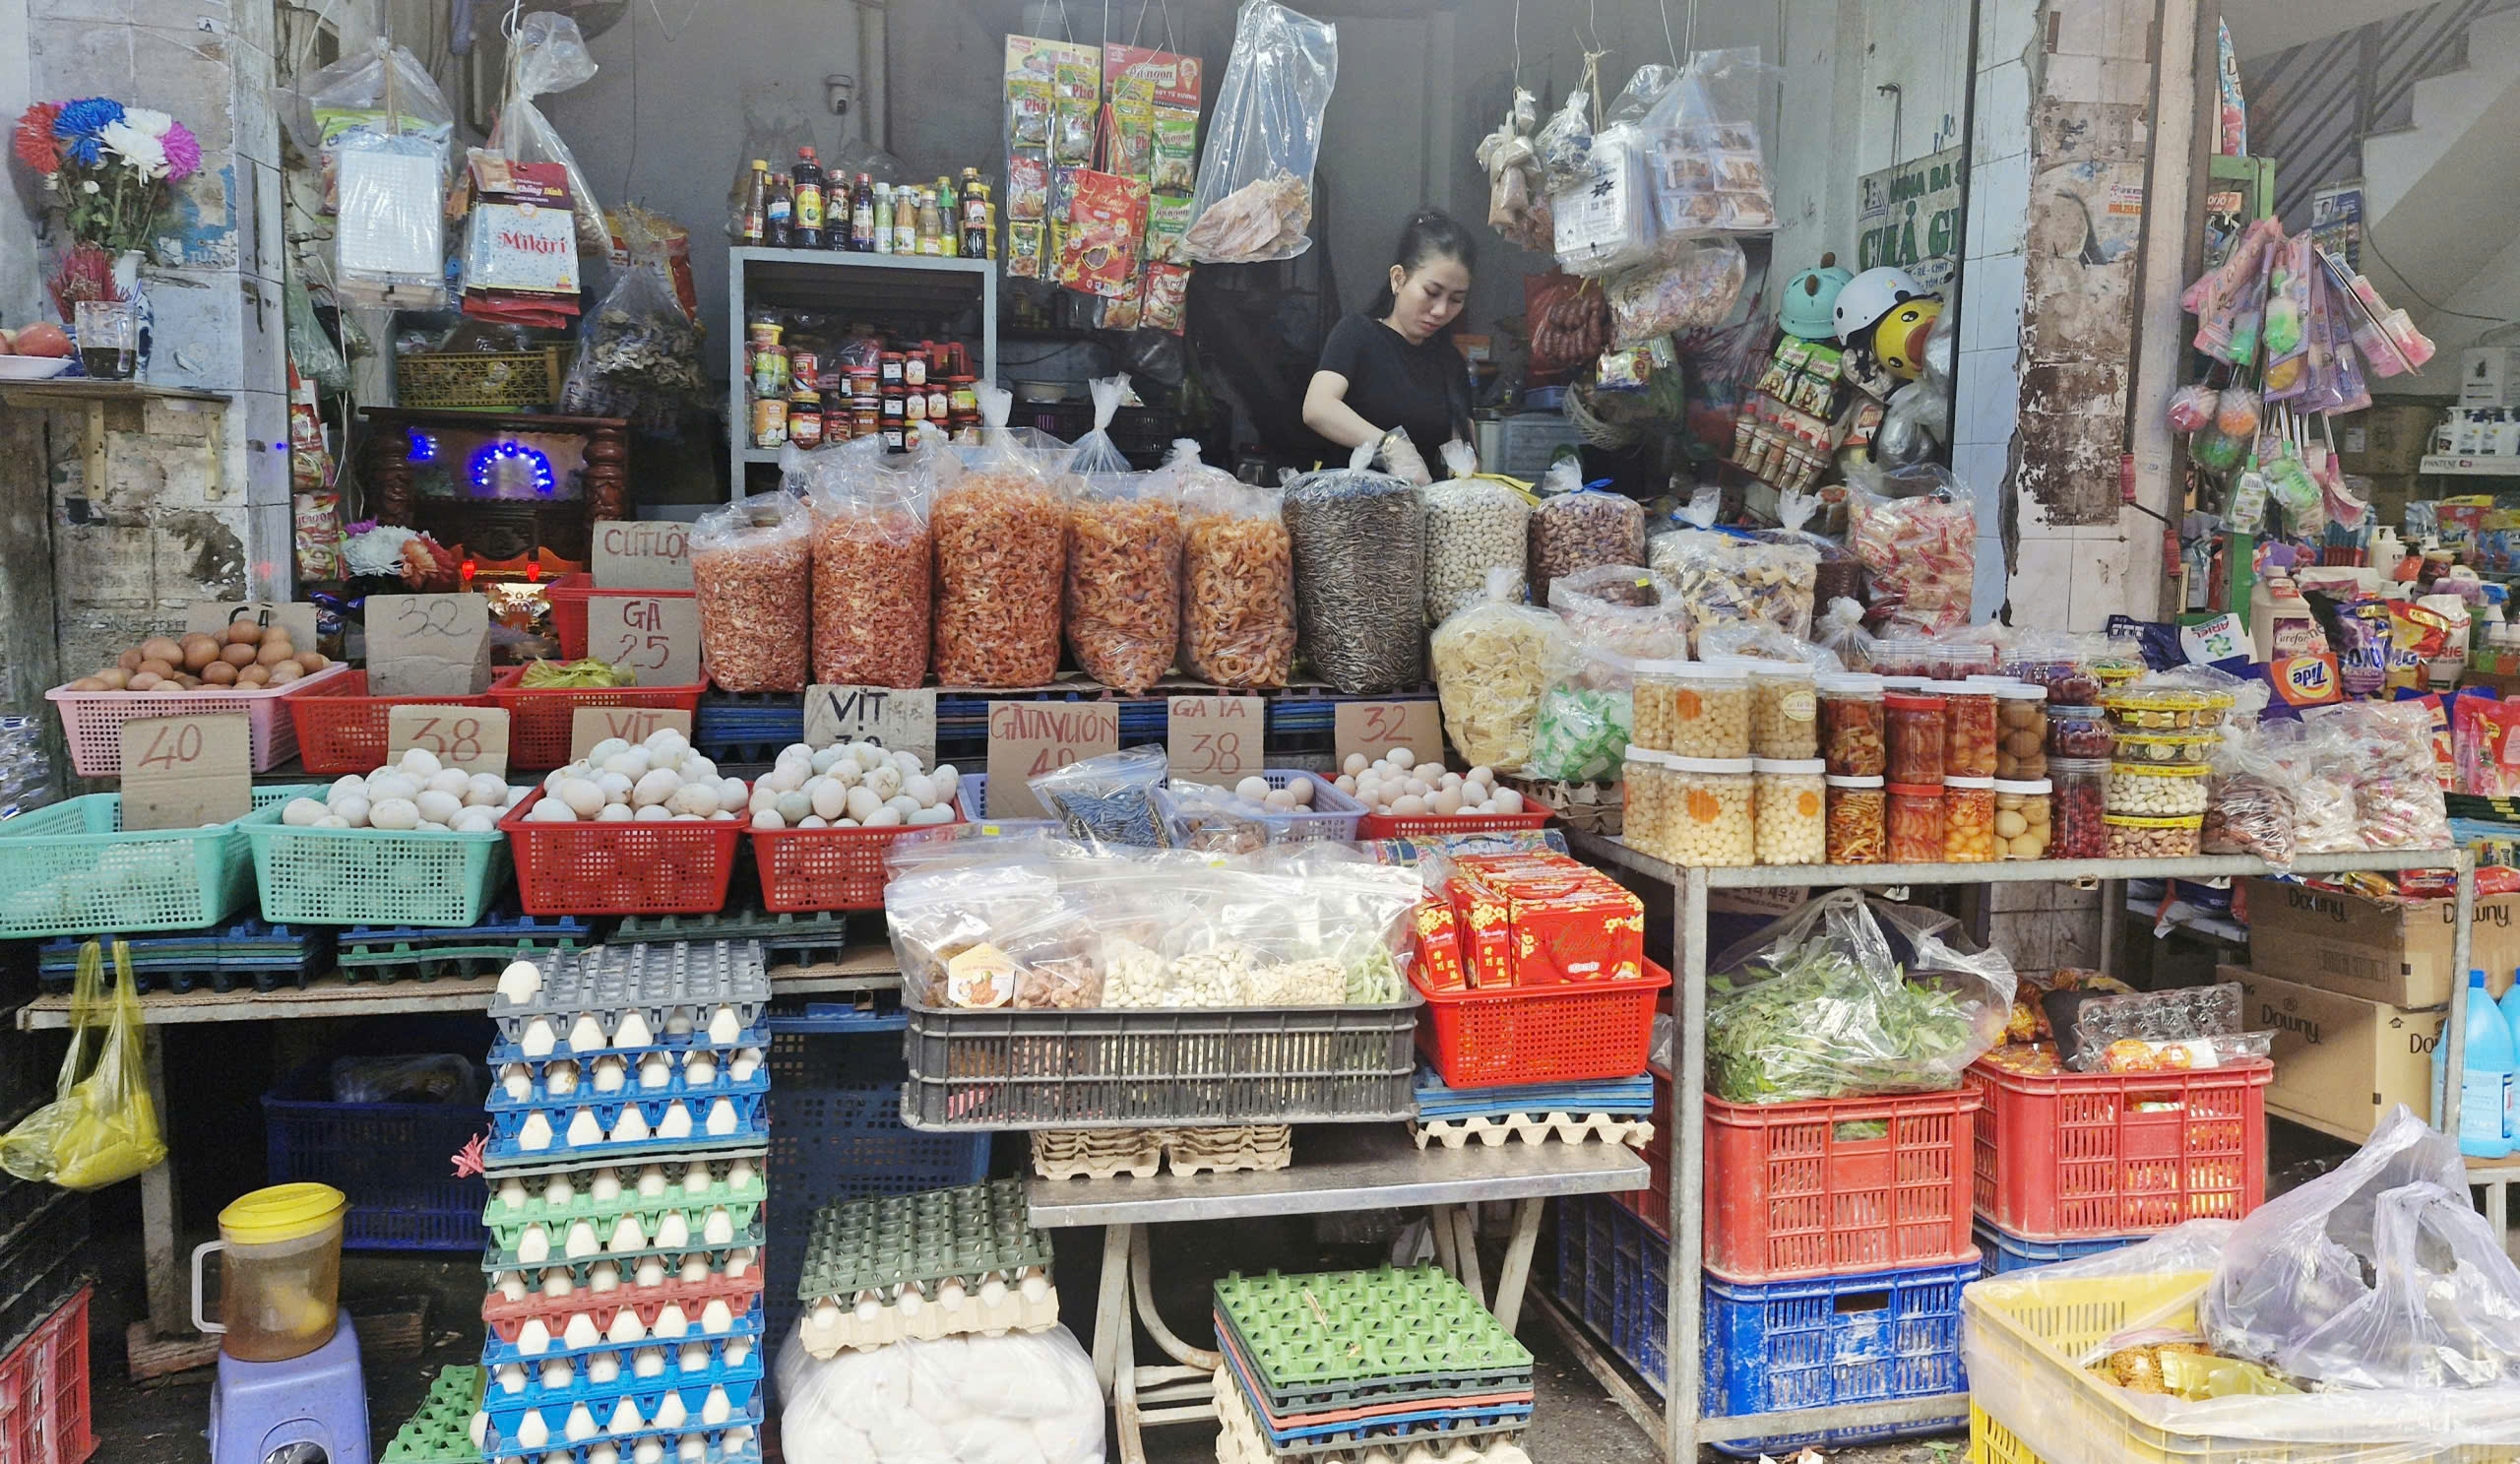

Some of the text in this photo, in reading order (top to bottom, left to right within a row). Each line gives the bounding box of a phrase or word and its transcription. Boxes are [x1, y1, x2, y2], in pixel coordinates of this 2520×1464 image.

[1025, 98, 1047, 113] Phở
[398, 598, 472, 639] 32
[623, 598, 662, 632] GÀ
[2192, 620, 2230, 639] ARIEL
[612, 633, 669, 669] 25
[2293, 661, 2328, 687] Tide
[829, 688, 889, 731] VỊT
[1212, 698, 1245, 718] TA
[1360, 705, 1415, 744] 32
[138, 723, 203, 771] 40
[411, 717, 482, 763] 38
[1189, 732, 1240, 775] 38
[1028, 748, 1075, 777] 40
[2289, 887, 2347, 923] Downy
[2443, 902, 2510, 927] Dwny
[2262, 1003, 2321, 1045] Downy
[2410, 1033, 2438, 1054] Do
